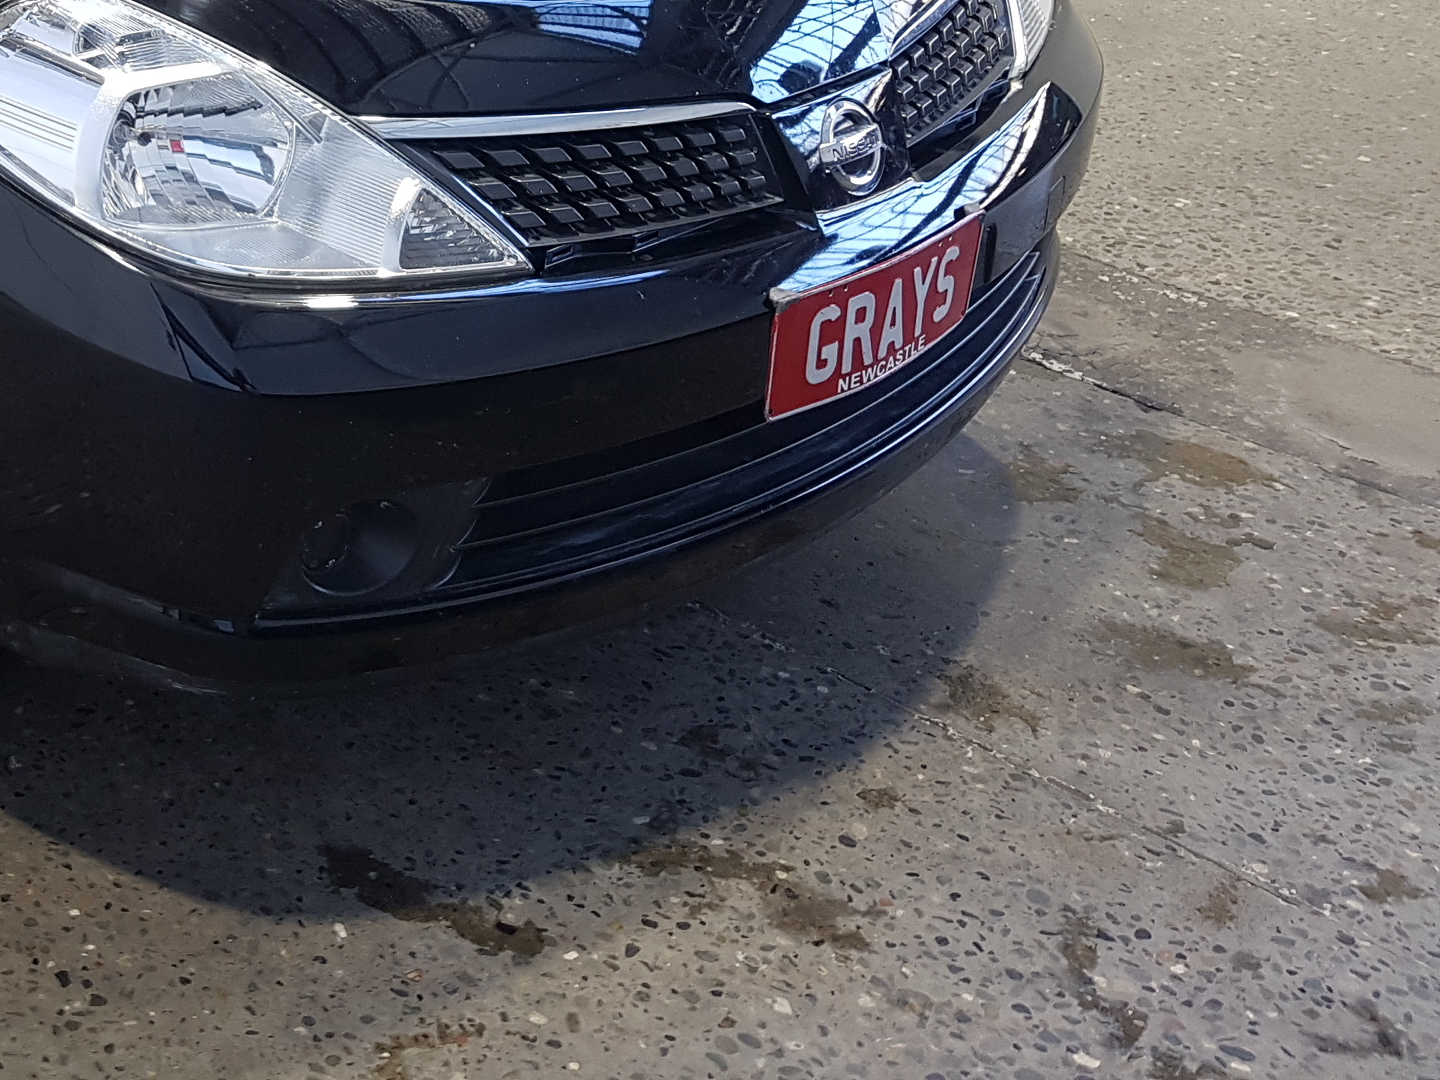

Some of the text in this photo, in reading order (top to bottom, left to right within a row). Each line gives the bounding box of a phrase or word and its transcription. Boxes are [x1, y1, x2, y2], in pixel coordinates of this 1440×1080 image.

[832, 128, 880, 161] NISSAN
[805, 245, 960, 385] GRAYS
[837, 334, 926, 393] NEWCASTLE
